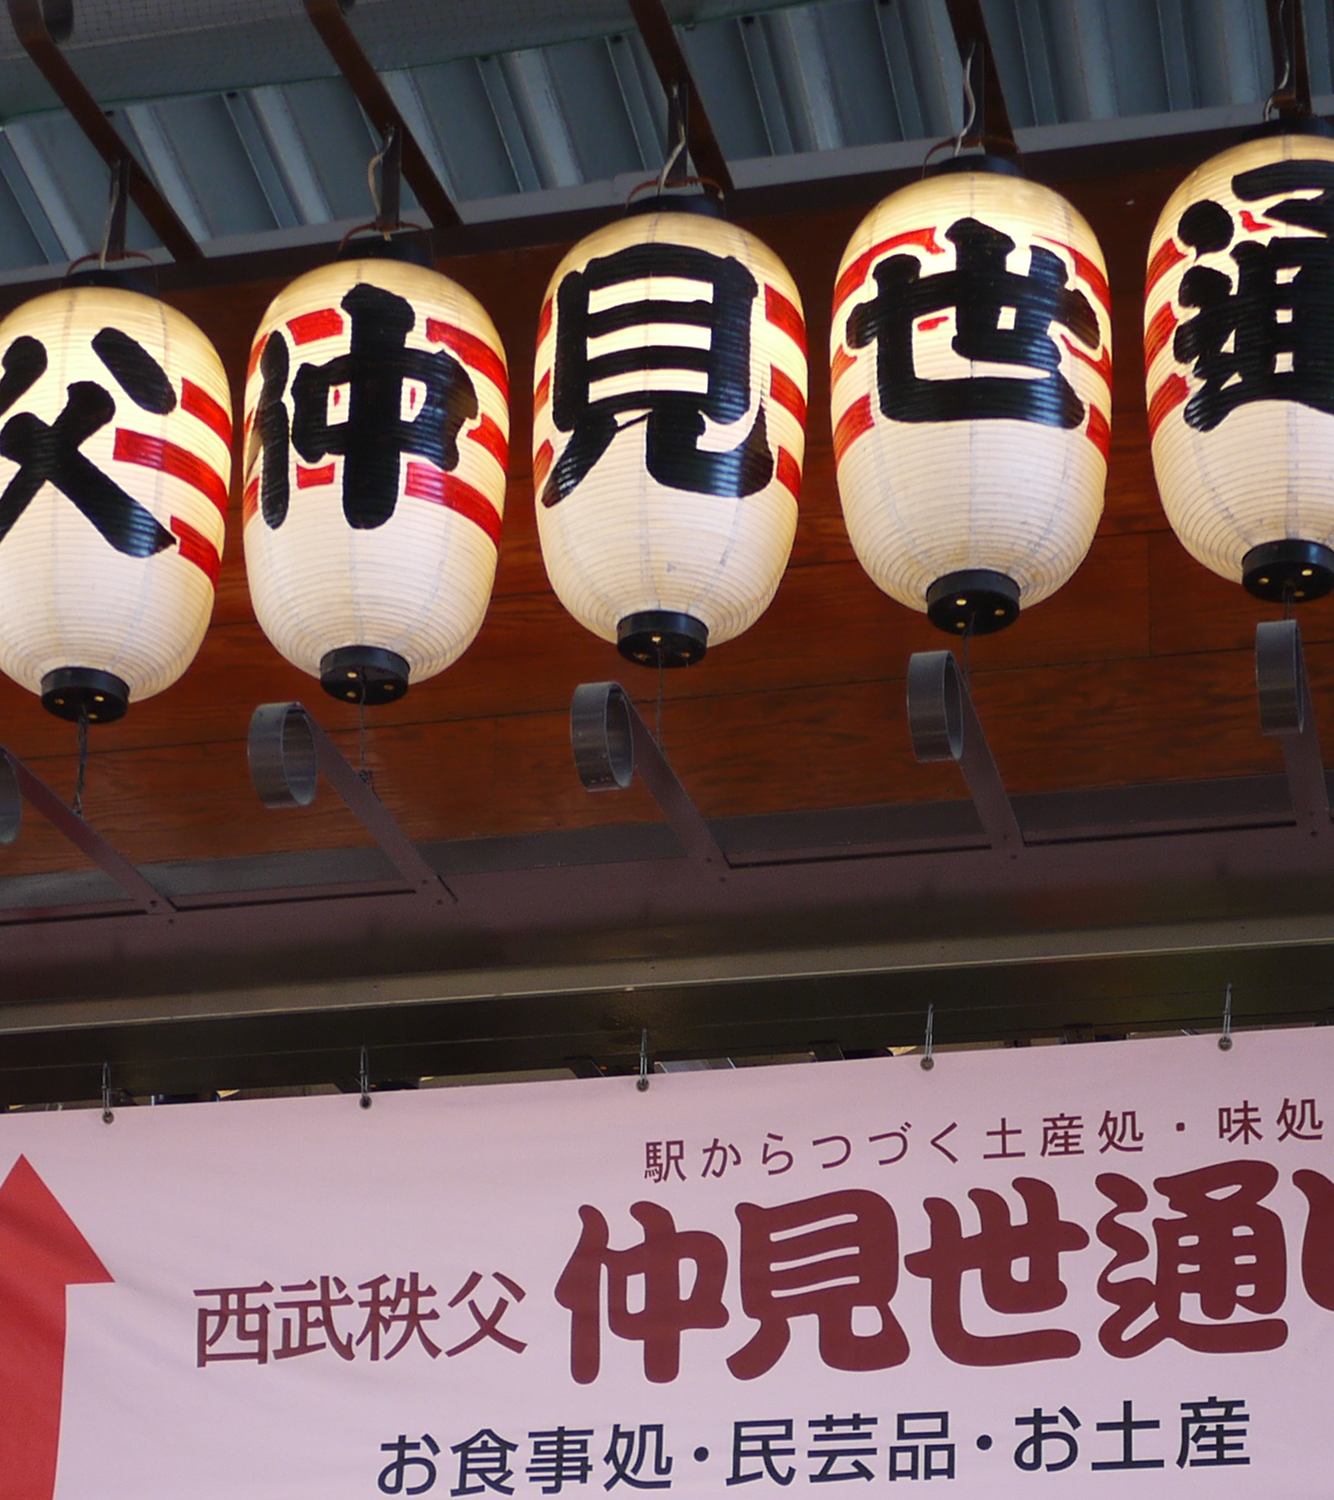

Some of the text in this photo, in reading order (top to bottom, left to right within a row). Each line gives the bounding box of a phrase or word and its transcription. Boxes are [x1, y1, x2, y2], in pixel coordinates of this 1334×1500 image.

[644, 1097, 1327, 1185] 駅からつづく土産処・味処
[192, 1270, 527, 1369] 西武秩父
[375, 1396, 1252, 1498] お食事処・民芸品・お土産
